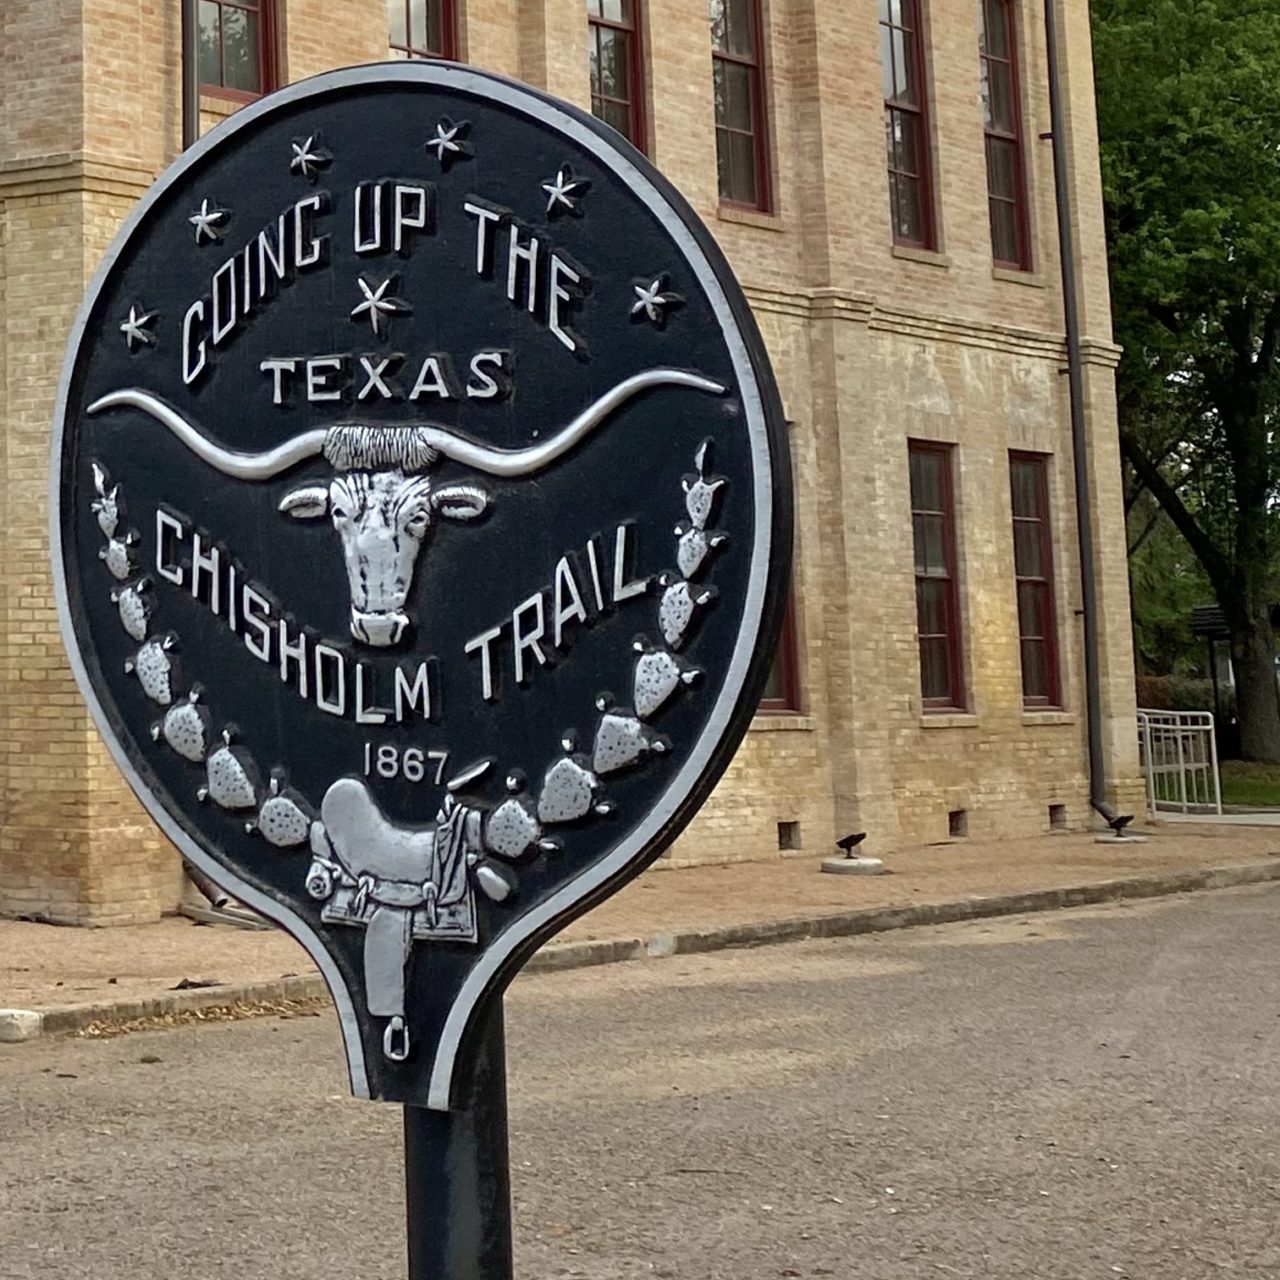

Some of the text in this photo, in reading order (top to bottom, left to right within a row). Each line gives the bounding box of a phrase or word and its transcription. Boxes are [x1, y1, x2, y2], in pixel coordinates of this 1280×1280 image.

[182, 186, 580, 384] GOING UP THE
[261, 353, 503, 404] TEXAS
[157, 510, 647, 723] CHISHOLM TRAIL
[364, 743, 449, 785] 1867
